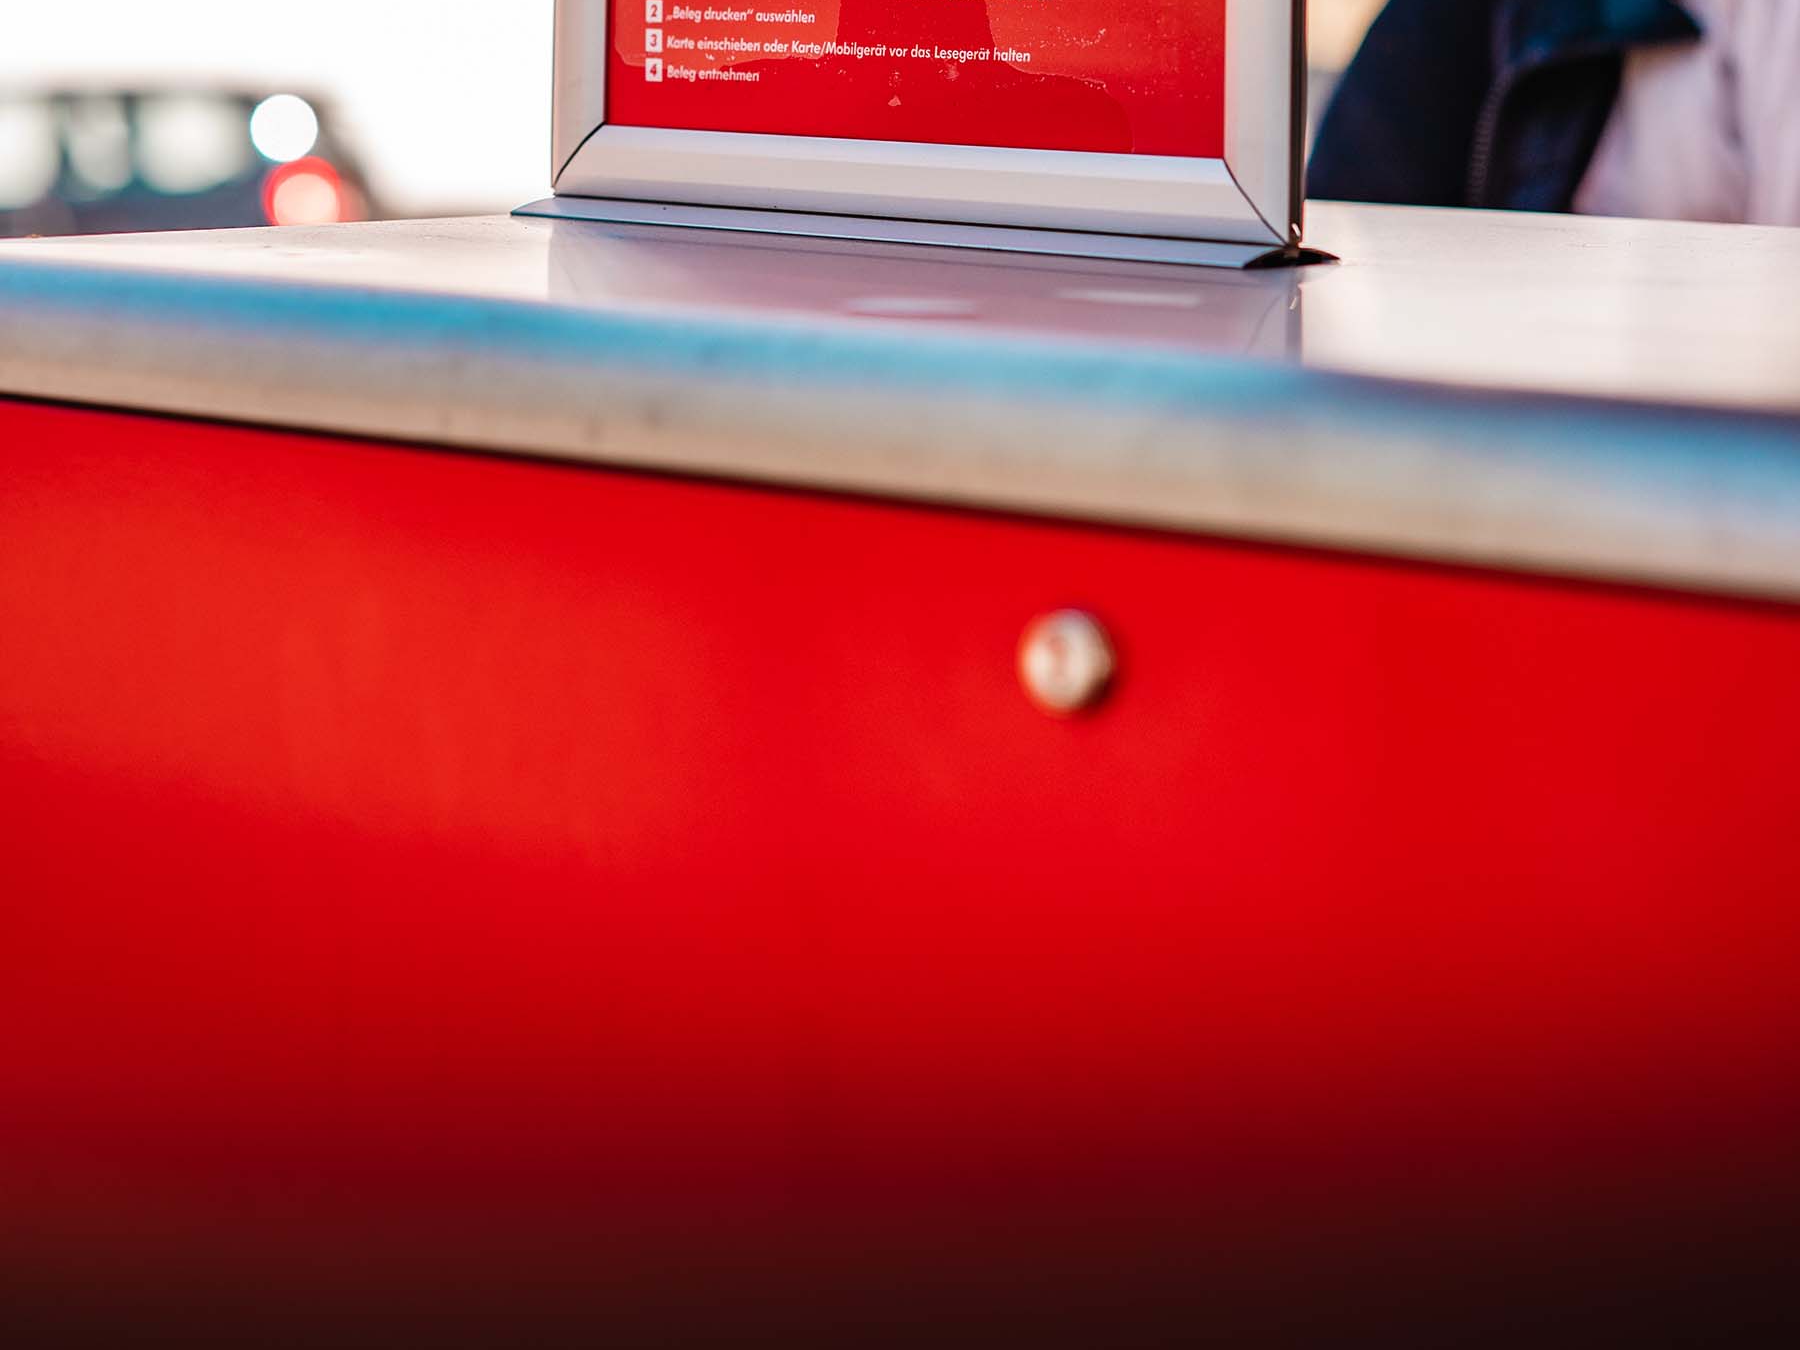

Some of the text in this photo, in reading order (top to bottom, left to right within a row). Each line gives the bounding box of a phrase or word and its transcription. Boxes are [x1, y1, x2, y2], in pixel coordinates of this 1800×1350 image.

[755, 9, 816, 24] auswählen
[666, 35, 696, 50] Karte
[696, 36, 762, 52] einschieben
[763, 38, 790, 53] oder
[790, 40, 887, 59] Karte/Mobilgerät
[888, 47, 909, 58] vor
[910, 44, 932, 58] das
[934, 44, 991, 63] Lesegerät
[992, 46, 1032, 63] halten
[666, 64, 697, 83] Beleg
[698, 67, 761, 82] entnehmen
